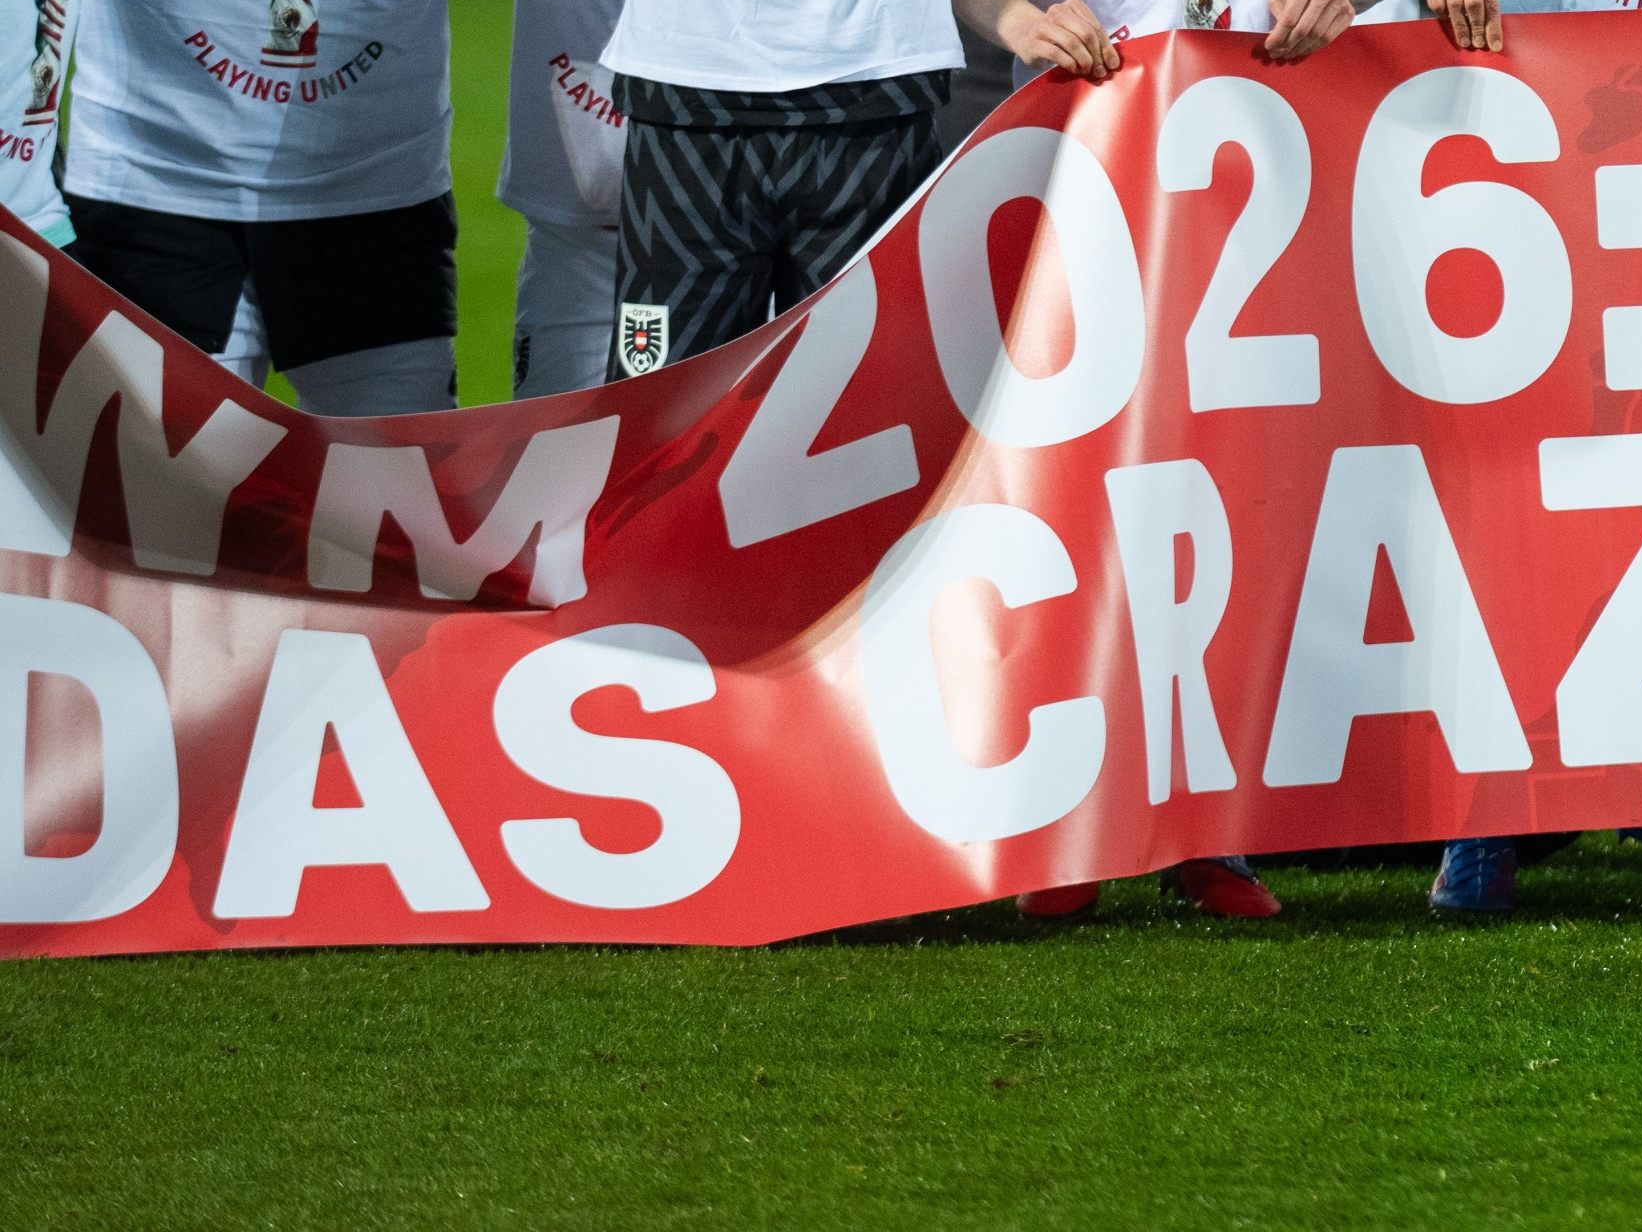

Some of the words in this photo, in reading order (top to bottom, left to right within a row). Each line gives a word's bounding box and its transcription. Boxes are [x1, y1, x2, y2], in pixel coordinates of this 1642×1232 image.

[184, 30, 292, 104] PLAYING
[301, 40, 385, 104] UNITED
[549, 52, 624, 129] PLAYIN
[0, 594, 742, 924] DAS
